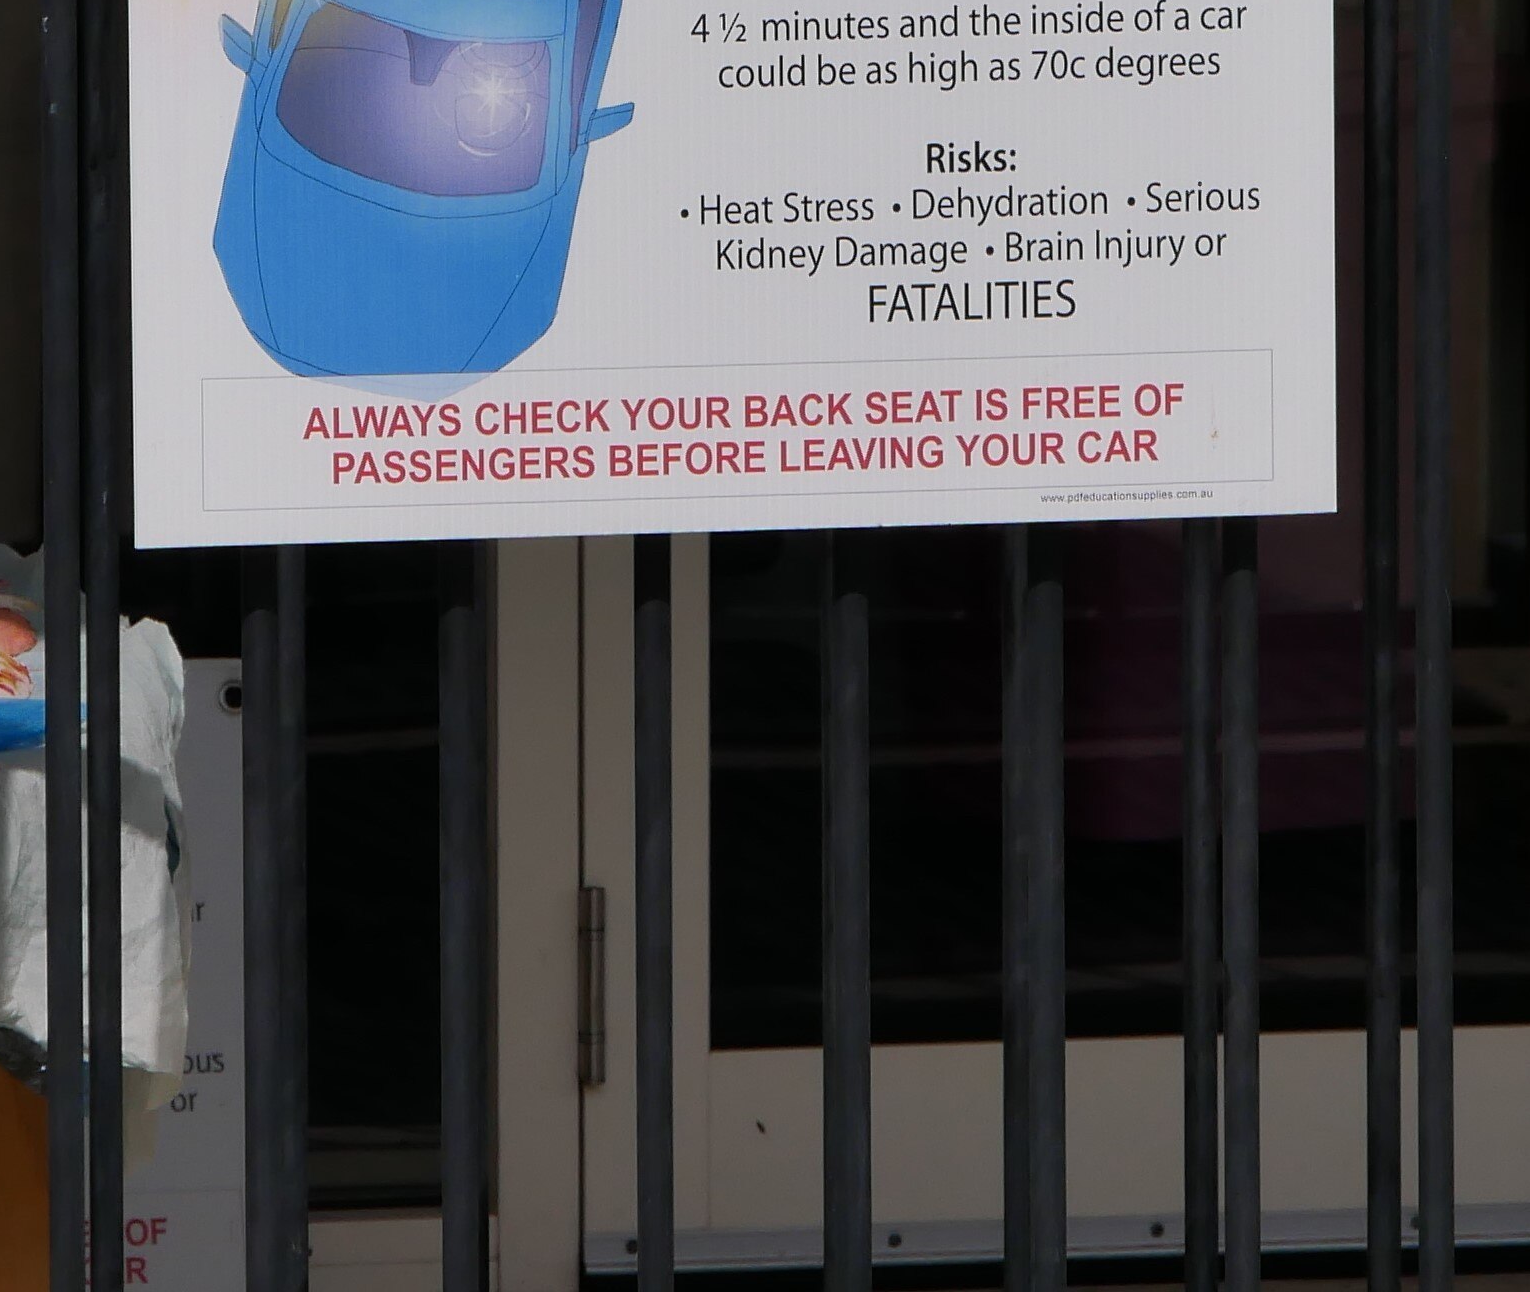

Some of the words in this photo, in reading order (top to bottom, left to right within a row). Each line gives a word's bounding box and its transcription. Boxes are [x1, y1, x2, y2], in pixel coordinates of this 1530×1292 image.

[691, 14, 710, 43] 4
[762, 11, 889, 41] minutes
[900, 5, 958, 38] and
[969, 4, 1021, 36] the
[1032, 1, 1124, 34] inside
[1134, 0, 1166, 32] of
[1174, 8, 1189, 30] a
[1201, 6, 1247, 30] car
[719, 54, 805, 88] could
[818, 54, 856, 85] be
[866, 61, 897, 84] as
[909, 50, 977, 91] high
[989, 58, 1020, 81] as
[1032, 50, 1085, 80] 70c
[1096, 46, 1220, 86] degrees
[927, 141, 1016, 173] Risks:
[701, 194, 773, 225] Heat
[784, 192, 874, 223] Stress
[913, 185, 1107, 226] Dehydration
[1147, 181, 1259, 213] Serious
[717, 237, 825, 277] Kidney
[836, 236, 967, 273] Damage
[1006, 231, 1083, 262] Brain
[1096, 229, 1185, 268] Injury
[1195, 234, 1227, 256] or
[869, 279, 1075, 322] FATALITIES
[303, 404, 461, 439] ALWAYS
[475, 400, 610, 435] CHECK
[621, 397, 731, 430] YOUR
[745, 393, 853, 427] BACK
[865, 390, 962, 424] SEAT
[976, 388, 1007, 421] IS
[1023, 385, 1121, 419] FREE
[1135, 383, 1184, 416] OF
[333, 445, 595, 484] PASSENGERS
[610, 441, 766, 476] BEFORE
[781, 436, 943, 472] LEAVING
[956, 433, 1065, 466] YOUR
[1078, 430, 1158, 463] CAR
[1039, 488, 1214, 506] www.pdfeducationsupplies.com.au
[125, 1218, 167, 1247] OF
